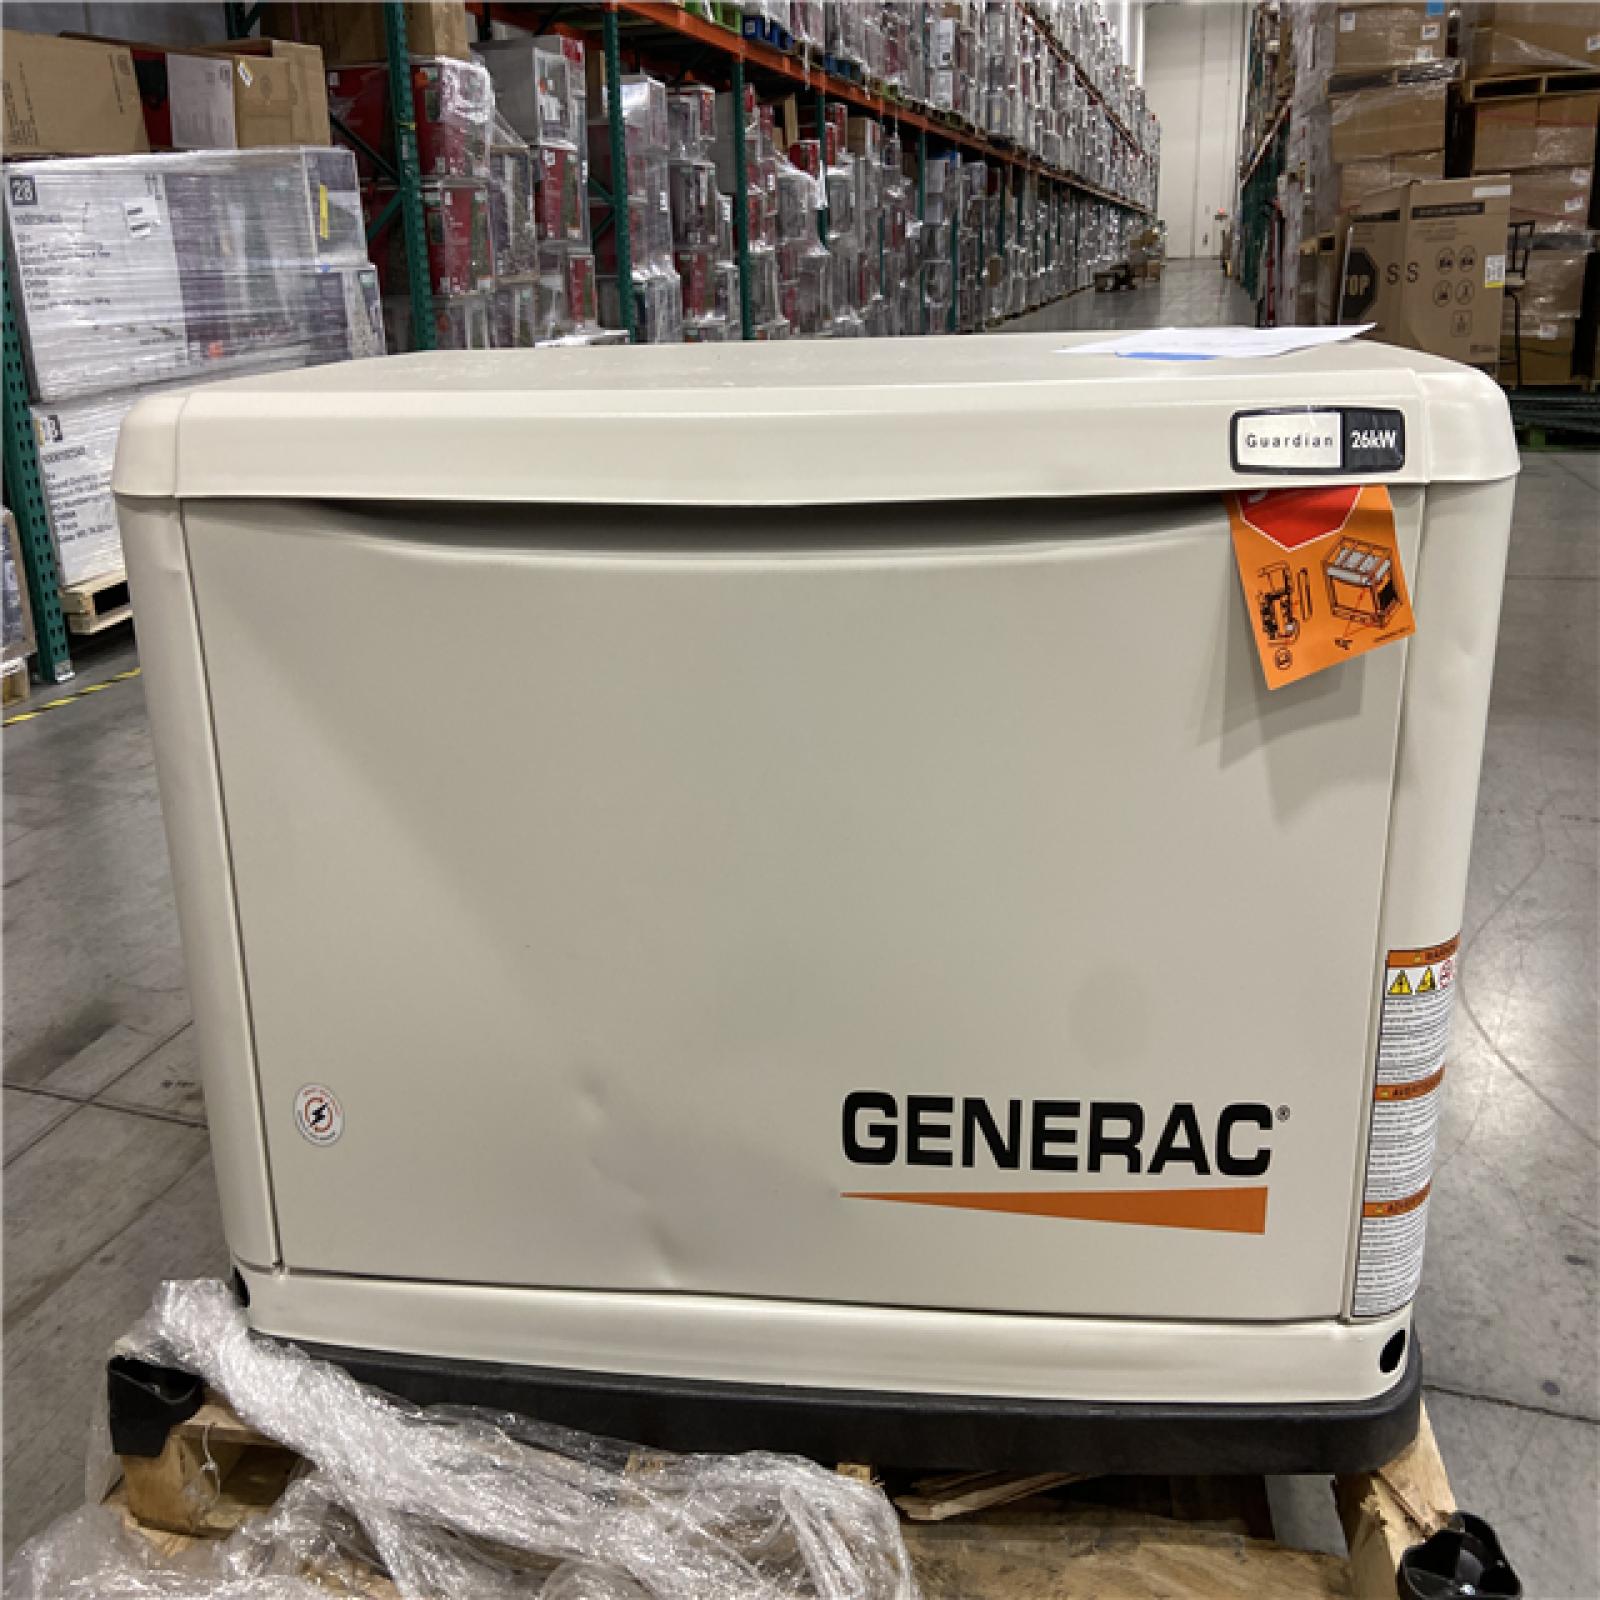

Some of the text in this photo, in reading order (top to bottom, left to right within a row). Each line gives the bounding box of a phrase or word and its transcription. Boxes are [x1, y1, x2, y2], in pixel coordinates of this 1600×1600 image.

[1245, 429, 1396, 449] Guardian 26kW
[842, 1089, 1273, 1177] GENERAC
